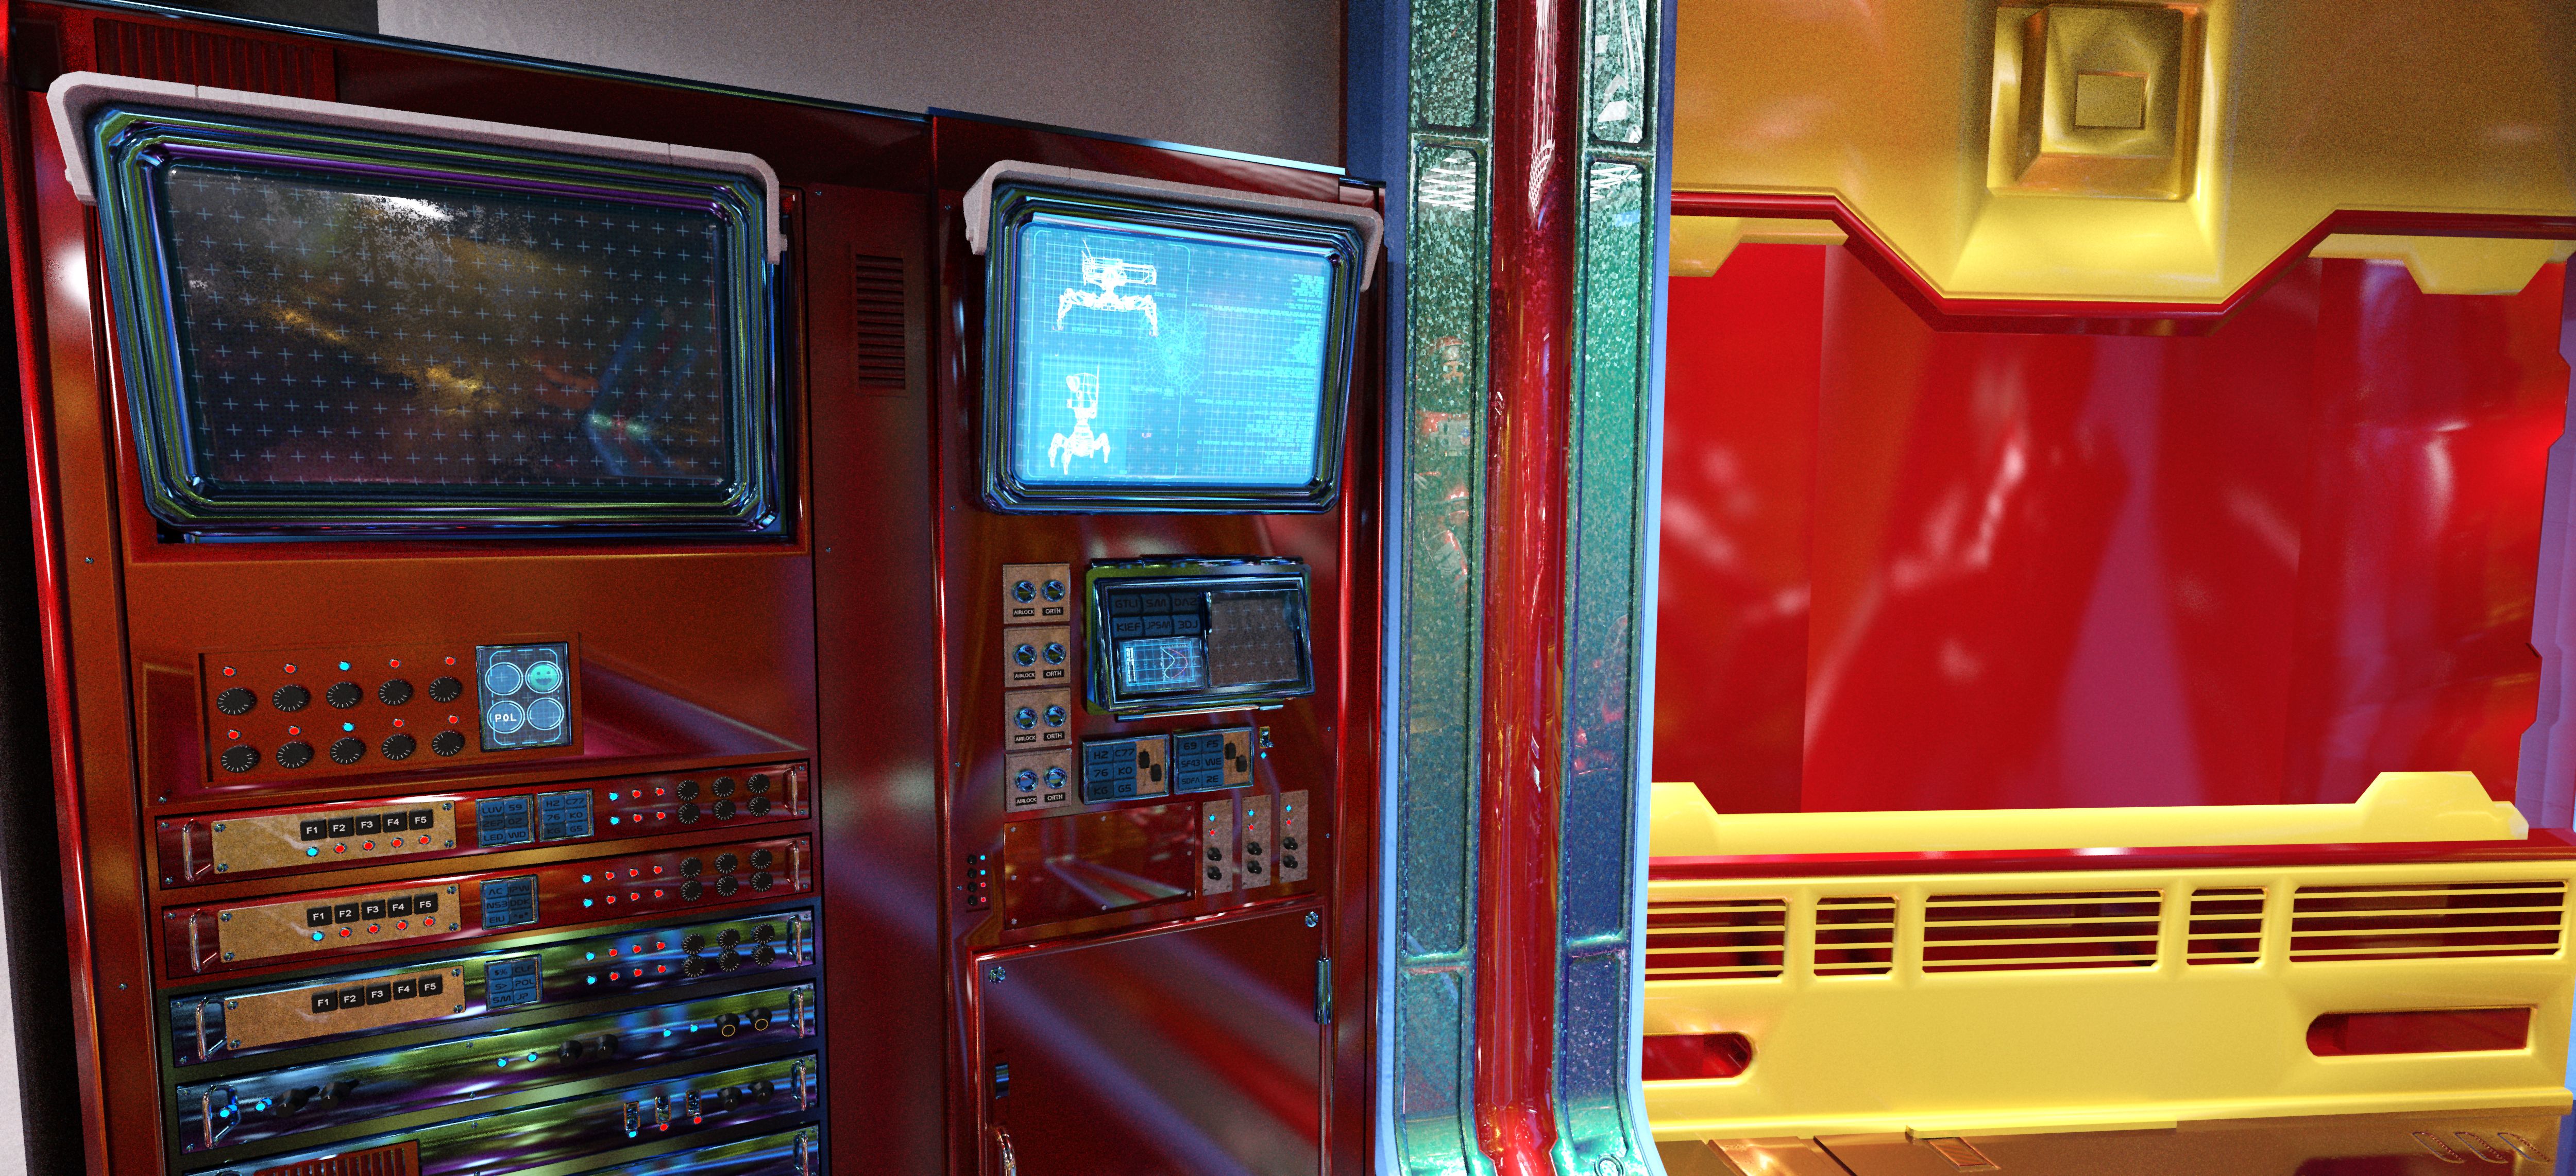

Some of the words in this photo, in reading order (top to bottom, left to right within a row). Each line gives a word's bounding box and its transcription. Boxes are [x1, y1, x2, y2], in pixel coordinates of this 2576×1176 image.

[1146, 599, 1166, 608] SM
[1117, 622, 1141, 632] KIEF
[1178, 620, 1198, 629] 3DJ
[495, 713, 517, 722] POL
[1183, 742, 1197, 751] 69
[1094, 751, 1108, 759] H2
[1115, 748, 1134, 757] C77
[1206, 758, 1222, 766] WE
[1094, 769, 1108, 777] 76
[1118, 785, 1131, 793] G5
[307, 826, 318, 834] F1
[361, 821, 373, 829] F3
[387, 818, 399, 826] F4
[415, 816, 427, 824] F5
[313, 912, 325, 921] F1
[339, 910, 351, 918] F2
[367, 906, 379, 914] F3
[420, 900, 432, 909] F5
